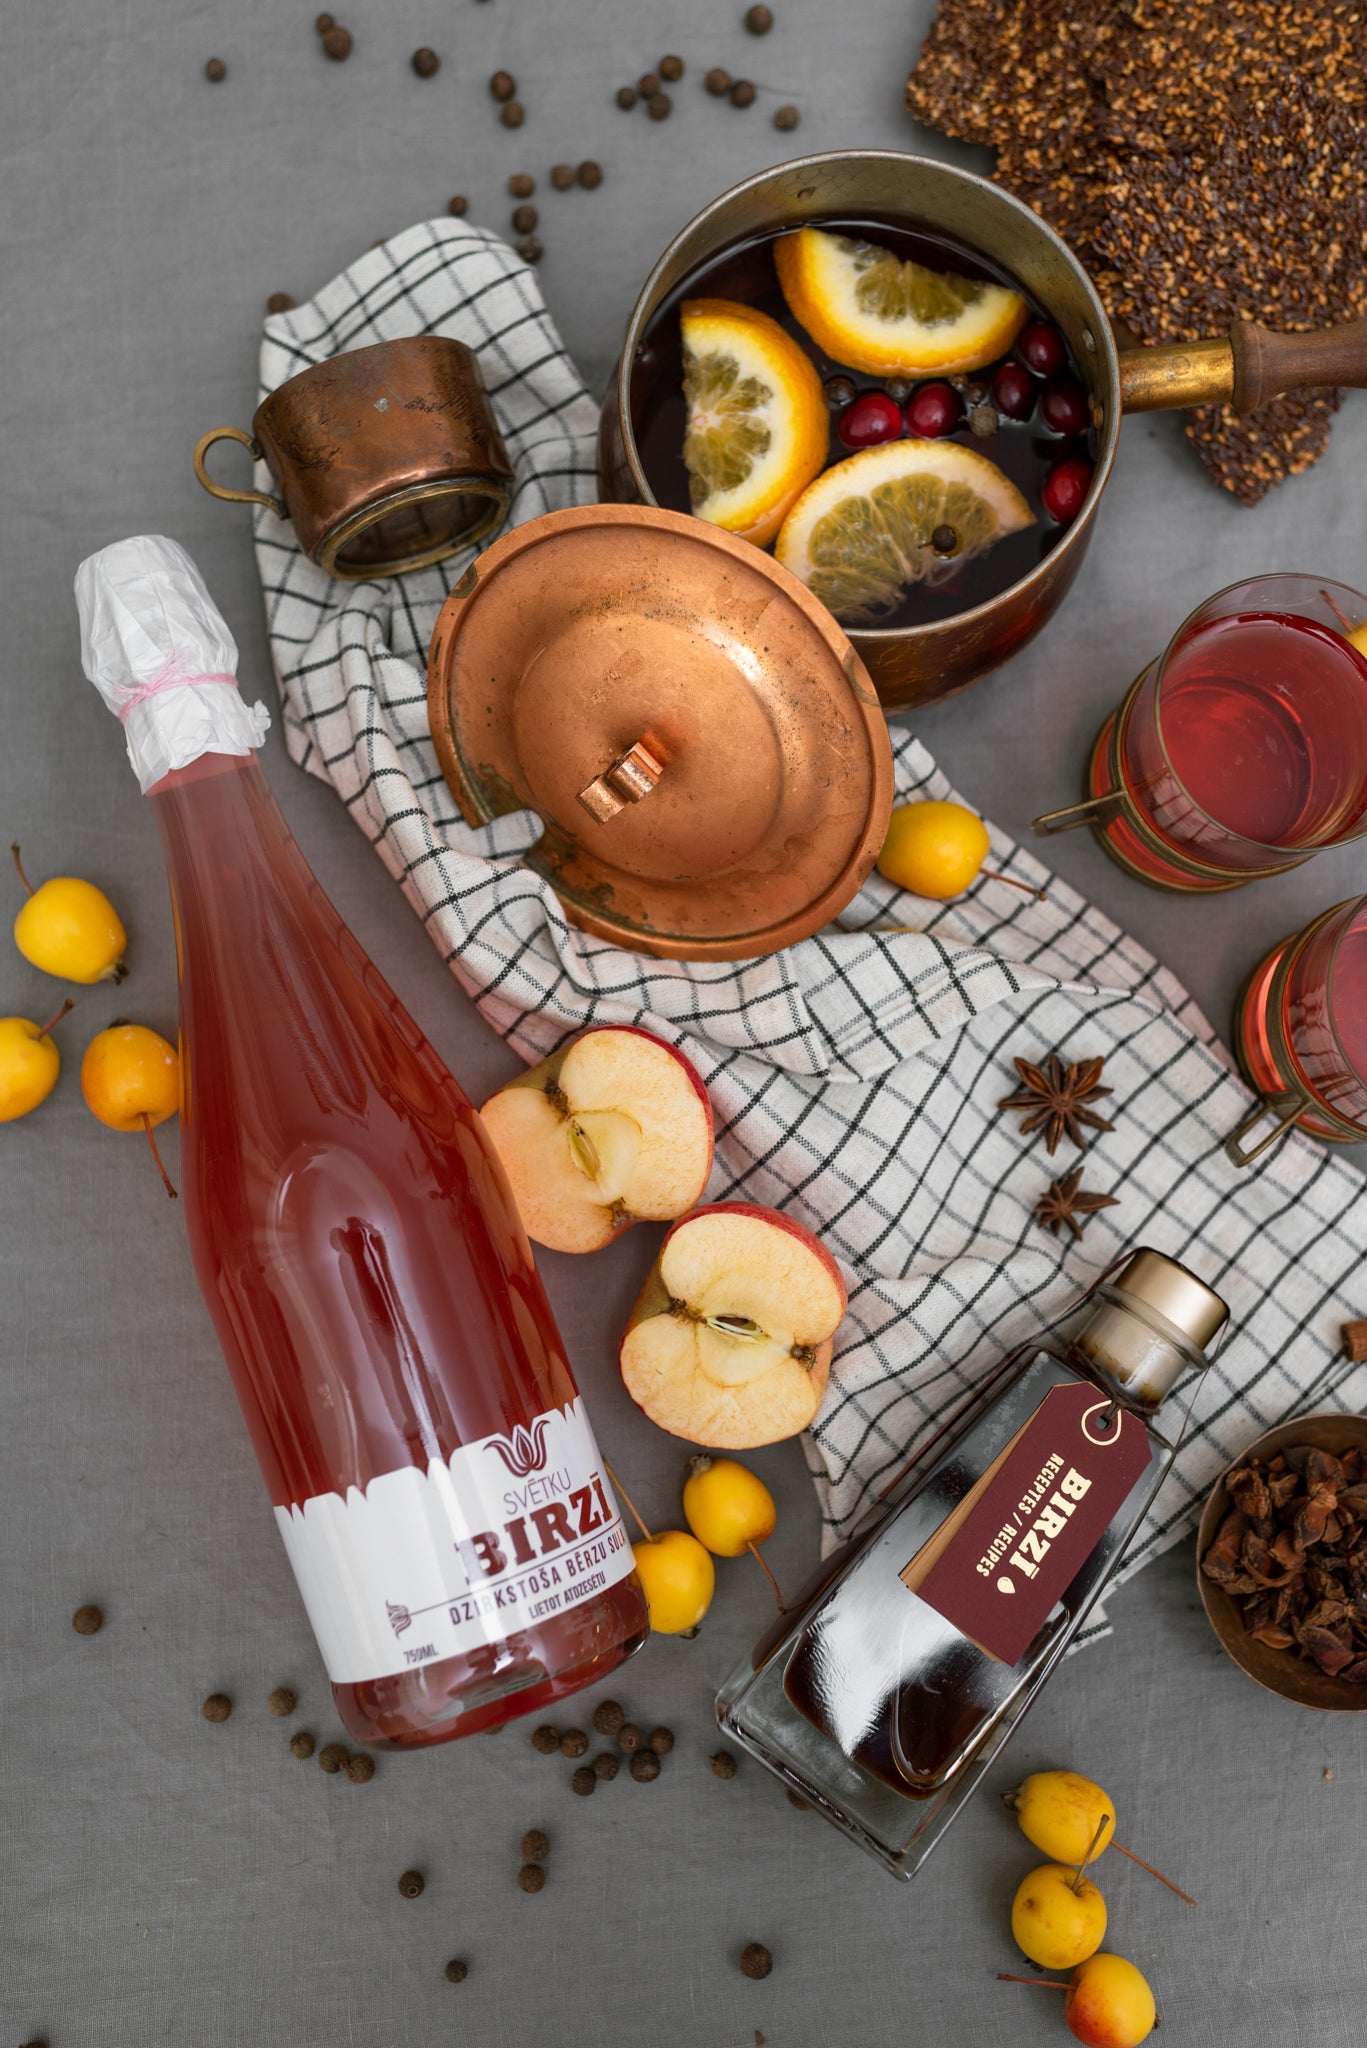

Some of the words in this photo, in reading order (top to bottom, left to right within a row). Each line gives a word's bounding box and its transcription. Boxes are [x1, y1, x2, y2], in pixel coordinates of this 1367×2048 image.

[503, 1467, 571, 1515] SVĒTKU
[1018, 1453, 1065, 1514] RECEPTES
[454, 1472, 613, 1586] BIRZĪ
[1009, 1467, 1092, 1579] BIRZĪ
[565, 1541, 607, 1578] BĒRZU
[976, 1523, 1017, 1577] RECIPES
[528, 1594, 561, 1619] LIETOT
[563, 1571, 606, 1604] ATDZESĒTU
[403, 1643, 439, 1664] 750ML
